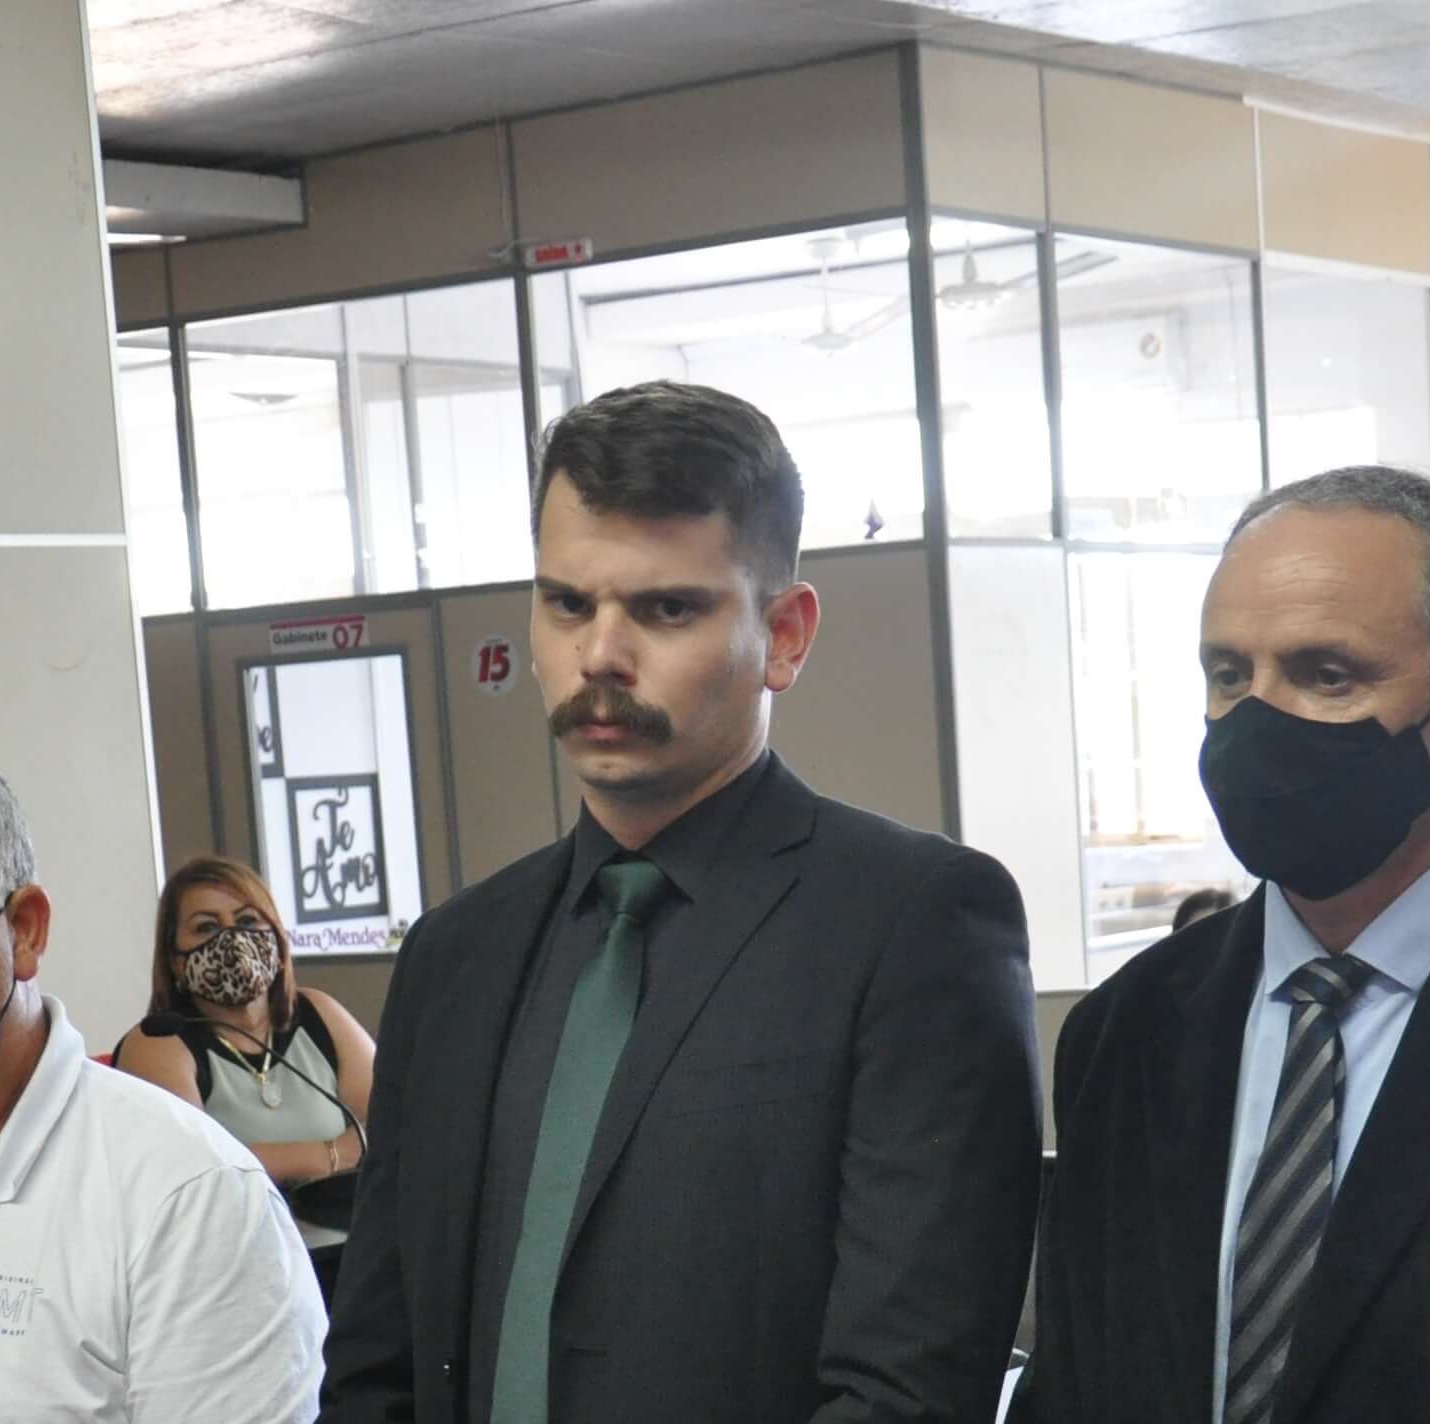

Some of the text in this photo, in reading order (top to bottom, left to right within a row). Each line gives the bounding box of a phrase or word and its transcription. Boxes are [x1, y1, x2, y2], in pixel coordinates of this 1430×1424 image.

[273, 624, 364, 648] Gabinete 07
[477, 643, 511, 683] 15
